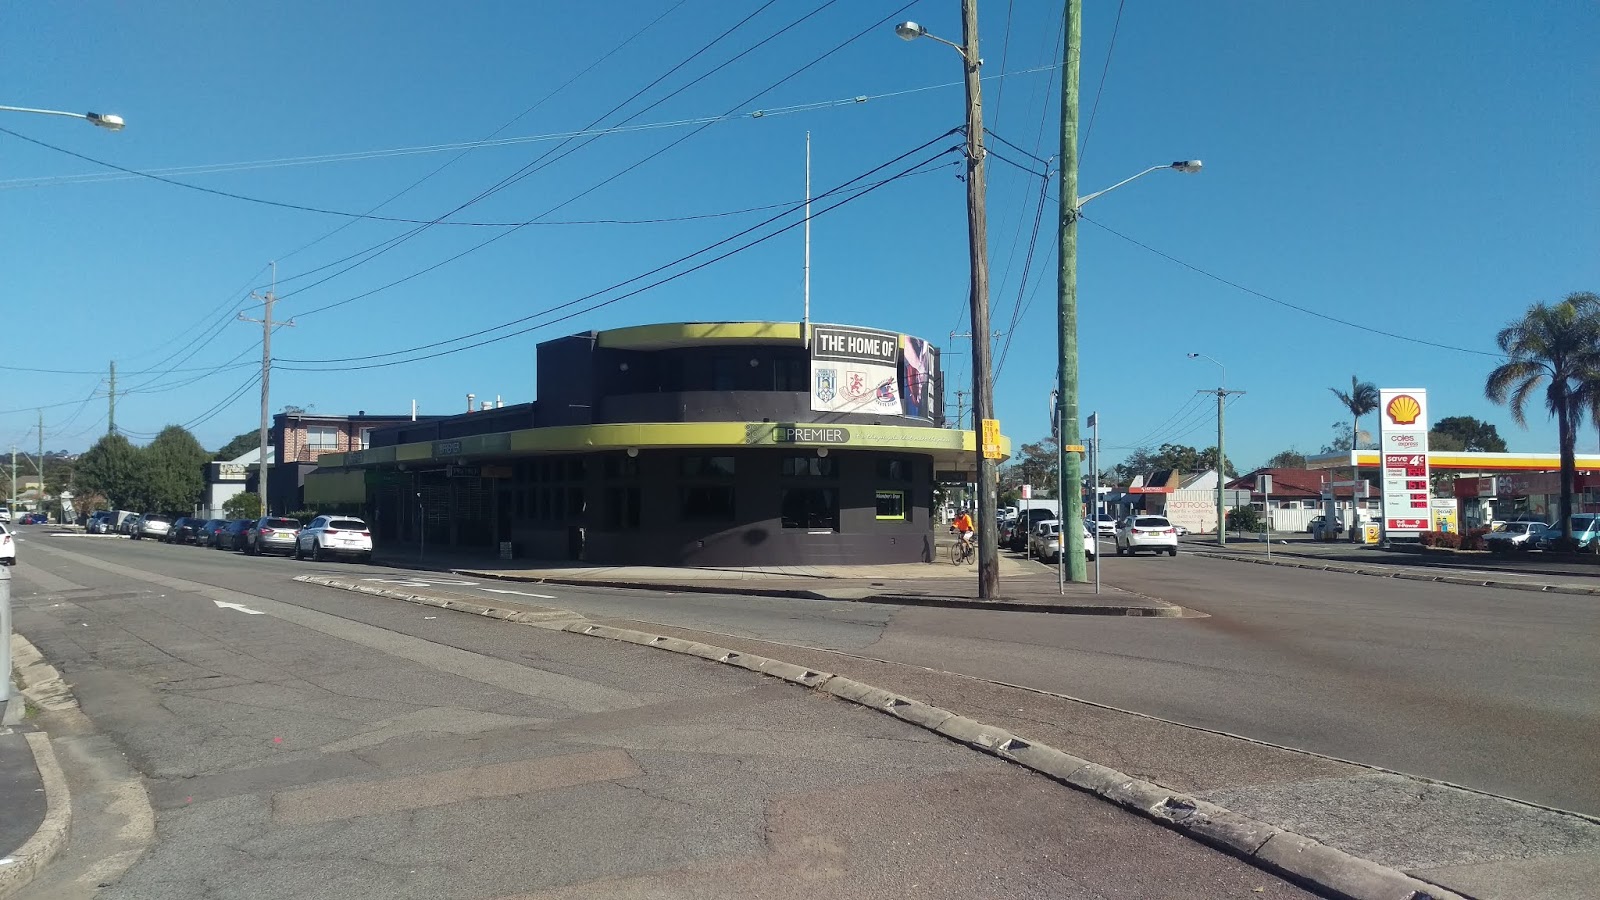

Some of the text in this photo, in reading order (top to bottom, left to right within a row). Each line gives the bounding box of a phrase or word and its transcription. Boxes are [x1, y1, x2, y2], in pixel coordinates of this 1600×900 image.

[820, 334, 894, 357] THE HOME OF
[786, 428, 843, 442] PREMIER
[1391, 434, 1414, 442] coles
